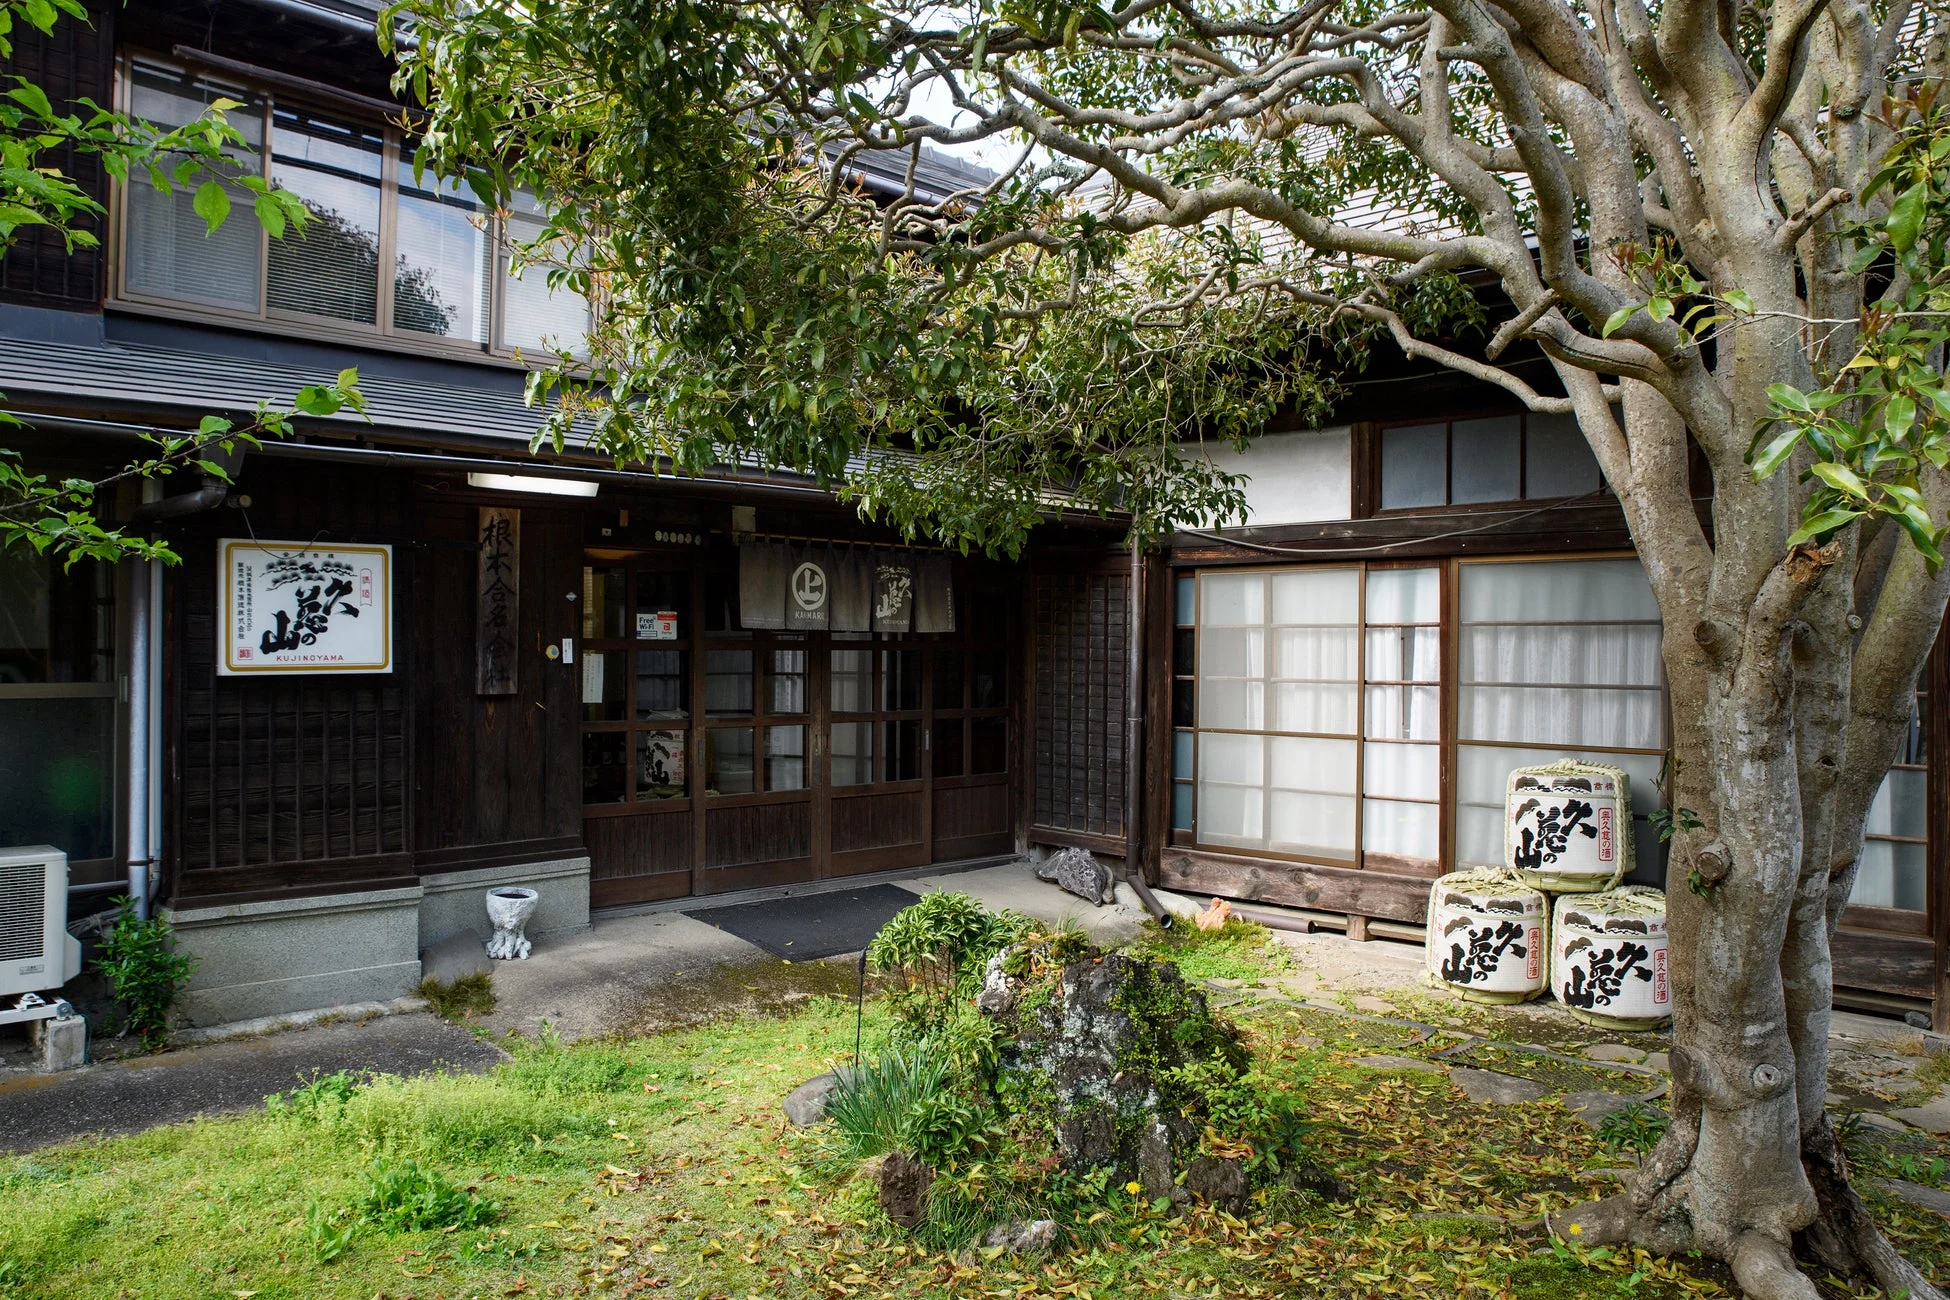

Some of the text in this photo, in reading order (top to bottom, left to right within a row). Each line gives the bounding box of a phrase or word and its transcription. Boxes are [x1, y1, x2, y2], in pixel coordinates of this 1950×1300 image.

[260, 576, 360, 655] 久慈の山
[639, 616, 654, 624] Free
[1514, 799, 1597, 869] 久慈の山
[1601, 811, 1611, 858] 奥久慈の酒
[1441, 920, 1528, 984] 久慈の山
[1563, 941, 1653, 1009] 久慈の山
